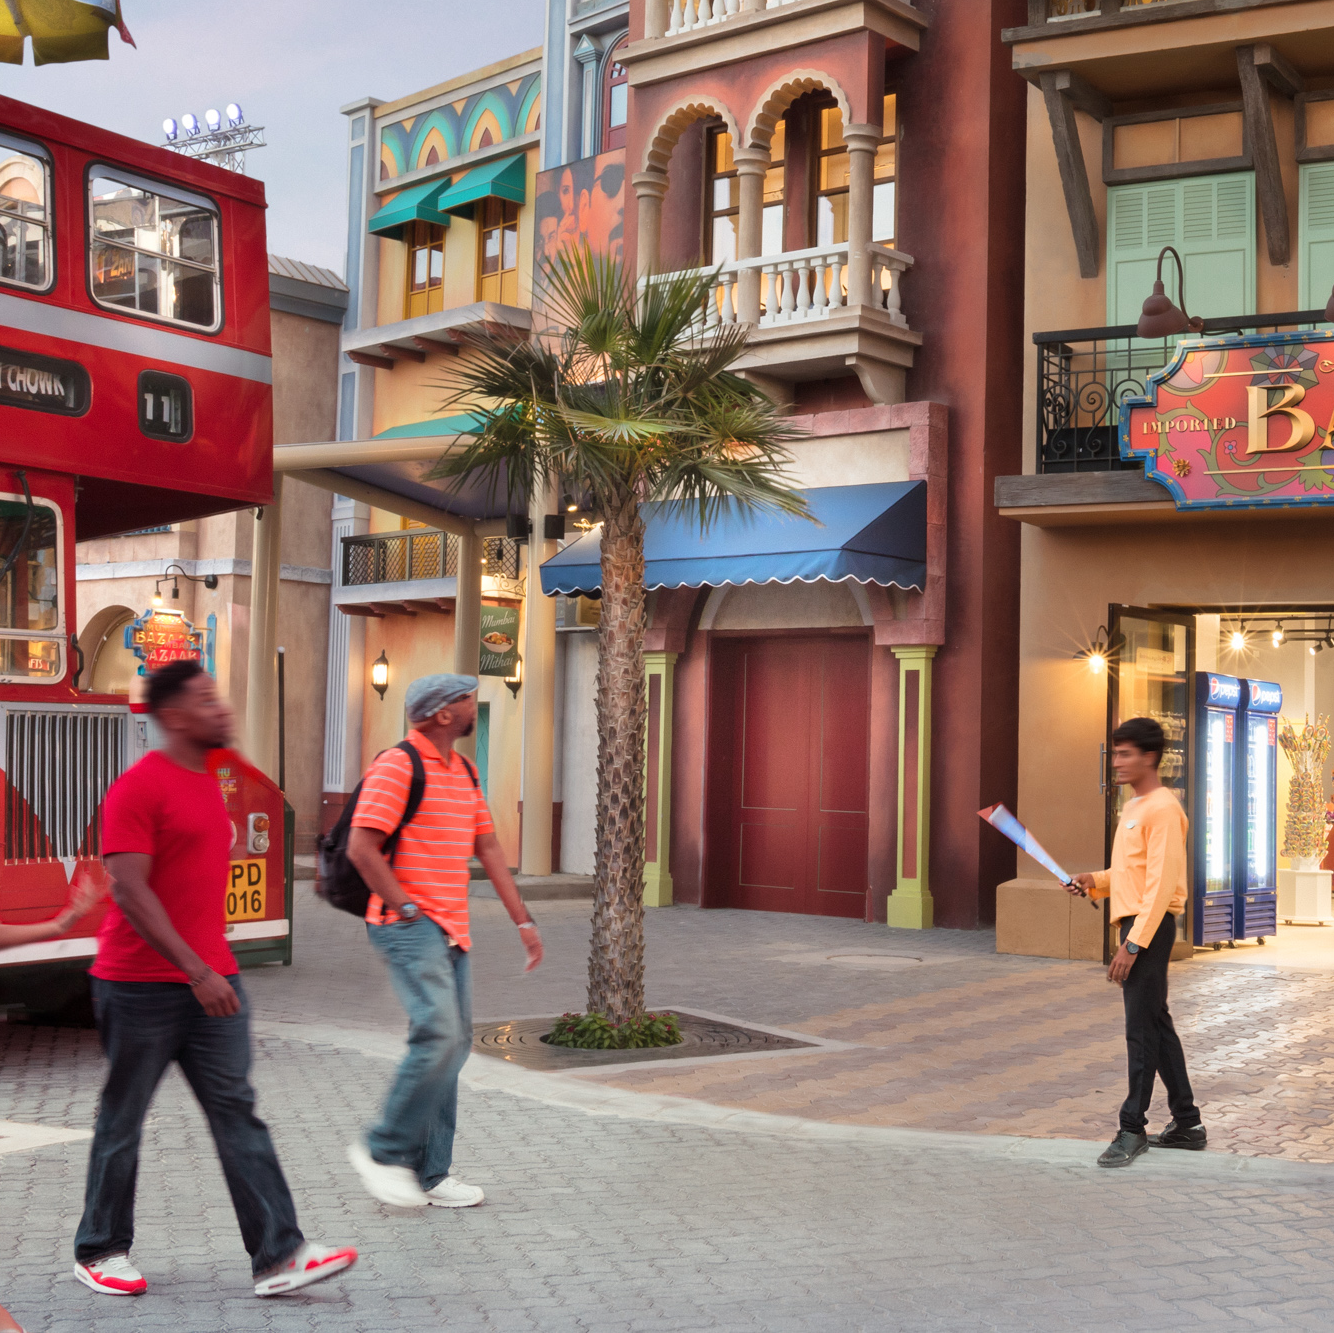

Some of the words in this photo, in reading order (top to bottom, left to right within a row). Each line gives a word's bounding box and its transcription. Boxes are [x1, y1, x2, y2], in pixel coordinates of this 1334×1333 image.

[6, 364, 65, 396] CHOWK
[144, 392, 170, 423] 11
[1142, 417, 1237, 435] IMPORTED
[482, 611, 516, 629] Mumbai
[149, 649, 197, 662] AZAAR
[480, 652, 515, 671] Mithai
